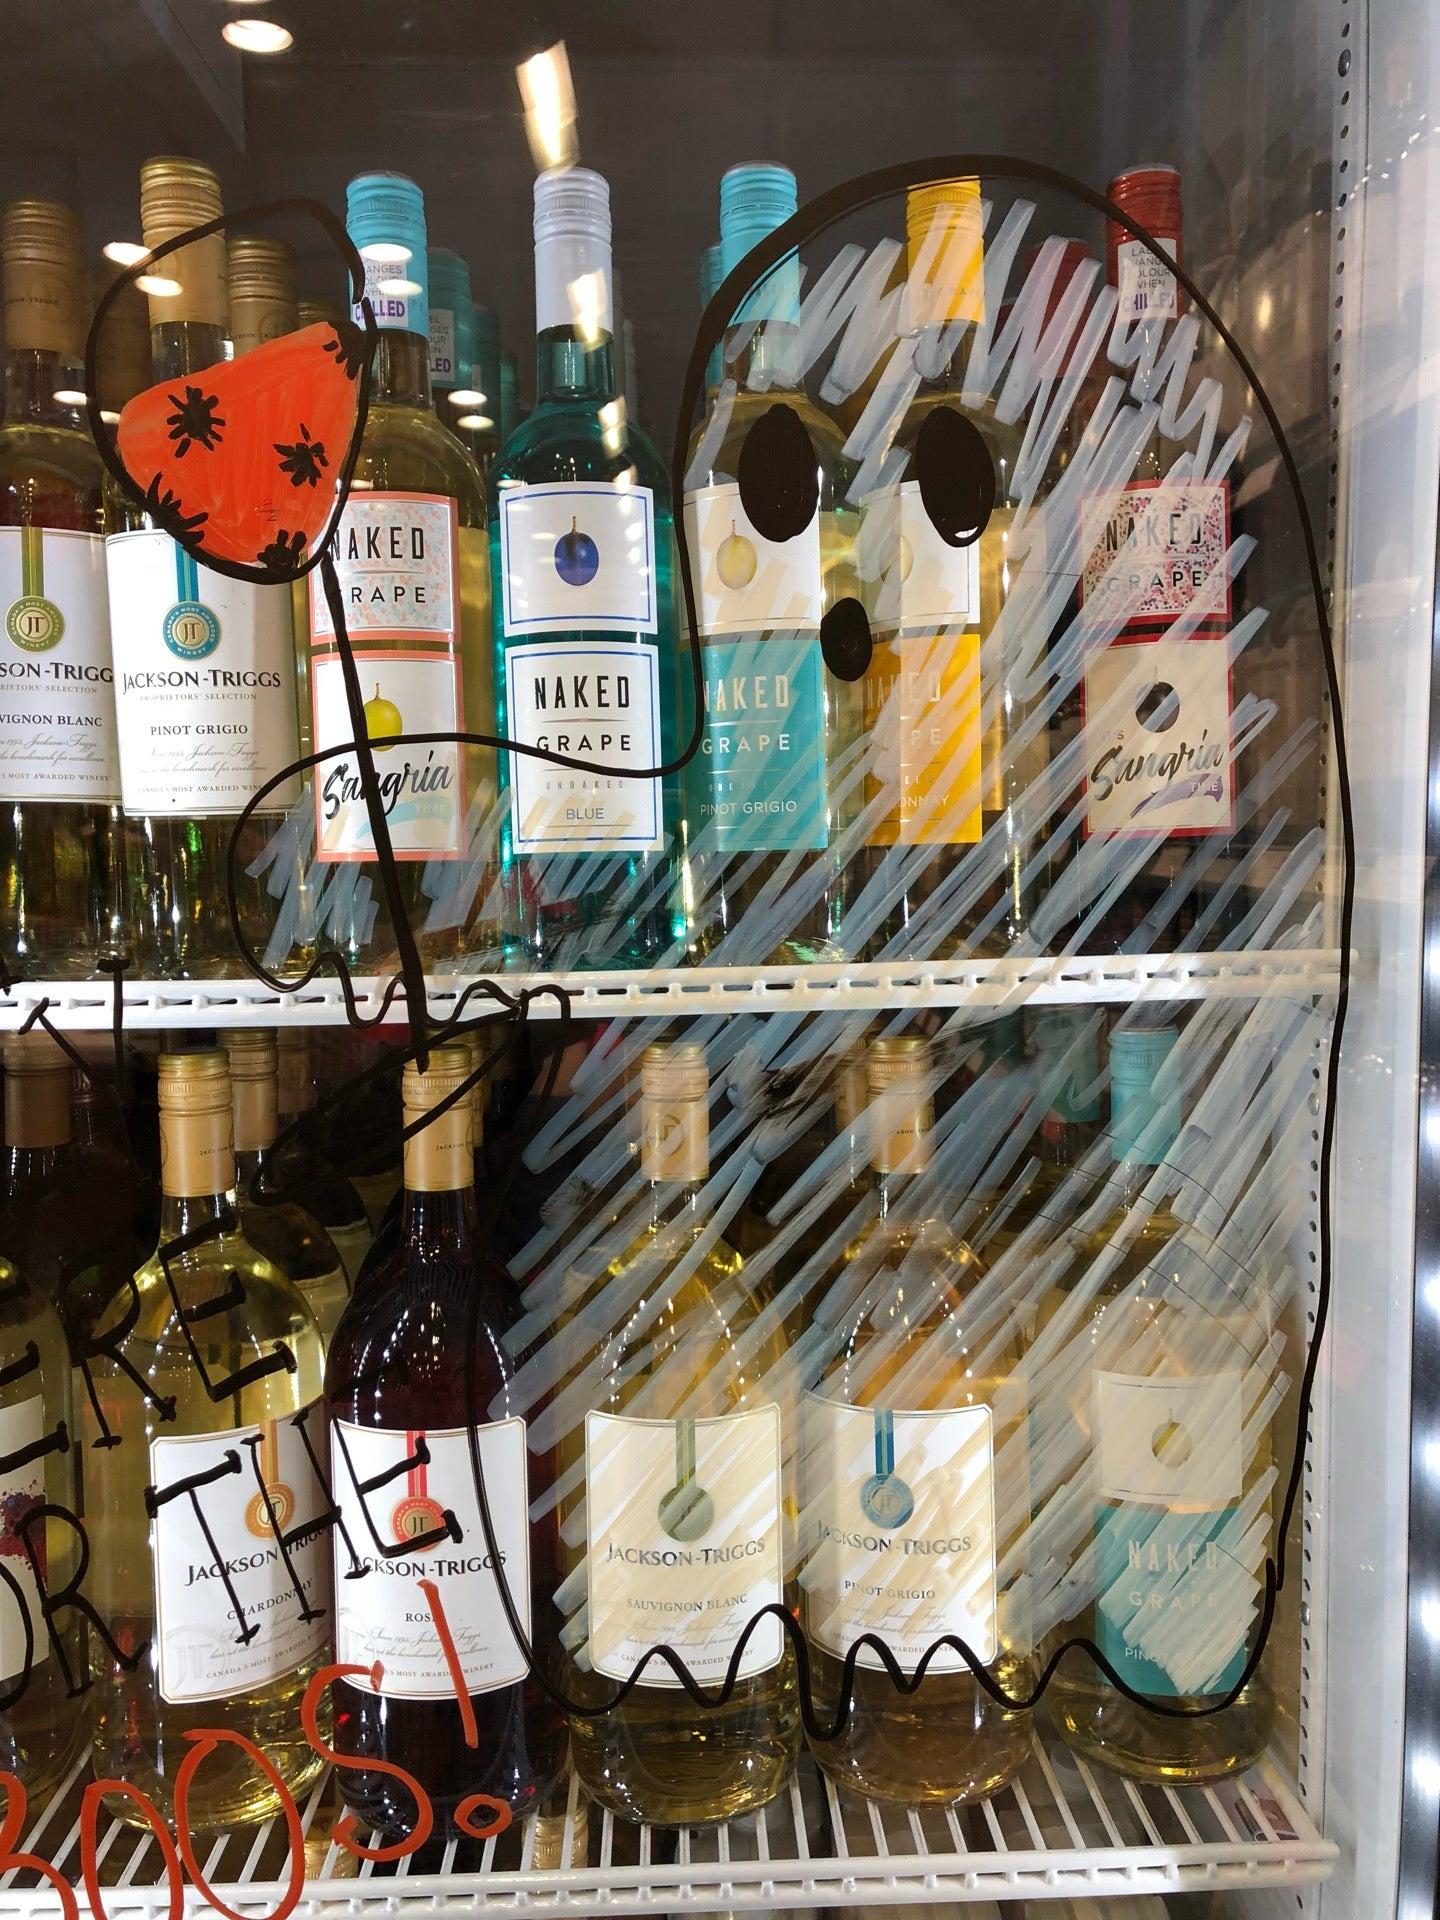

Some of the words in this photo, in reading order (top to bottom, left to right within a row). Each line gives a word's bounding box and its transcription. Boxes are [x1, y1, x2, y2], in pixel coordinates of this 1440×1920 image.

[1105, 513, 1202, 551] NAKED
[330, 526, 425, 562] NAKED
[1107, 571, 1202, 592] GRAPE
[351, 586, 426, 603] RAPE
[26, 616, 45, 637] JT
[182, 622, 201, 643] JT
[46, 684, 97, 693] SELECTION
[123, 669, 281, 695] JACKSON-TRIGGS
[534, 675, 630, 710] NAKED
[57, 716, 103, 727] BLANC
[151, 725, 191, 736] PINOT
[196, 725, 248, 735] GRIGIO
[536, 734, 632, 752] GRAPE
[702, 733, 790, 755] GRAPE
[545, 780, 625, 790] UNOAKED
[566, 808, 605, 820] BLUE
[700, 802, 738, 816] PINOT
[742, 800, 797, 814] GRIGIO
[411, 1516, 429, 1536] JT
[817, 1521, 972, 1556] JACKSON-TRIGGS
[606, 1537, 766, 1567] JACKSON-TRIGGS
[1128, 1540, 1218, 1572] NAKED
[845, 1580, 883, 1596] PINOT
[887, 1589, 936, 1600] GRIGIO
[1130, 1591, 1217, 1609] GRAPE
[626, 1598, 703, 1612] SAUVIGNON
[707, 1594, 747, 1610] BLANC
[405, 1612, 435, 1623] ROS
[685, 1656, 724, 1667] AWARDED
